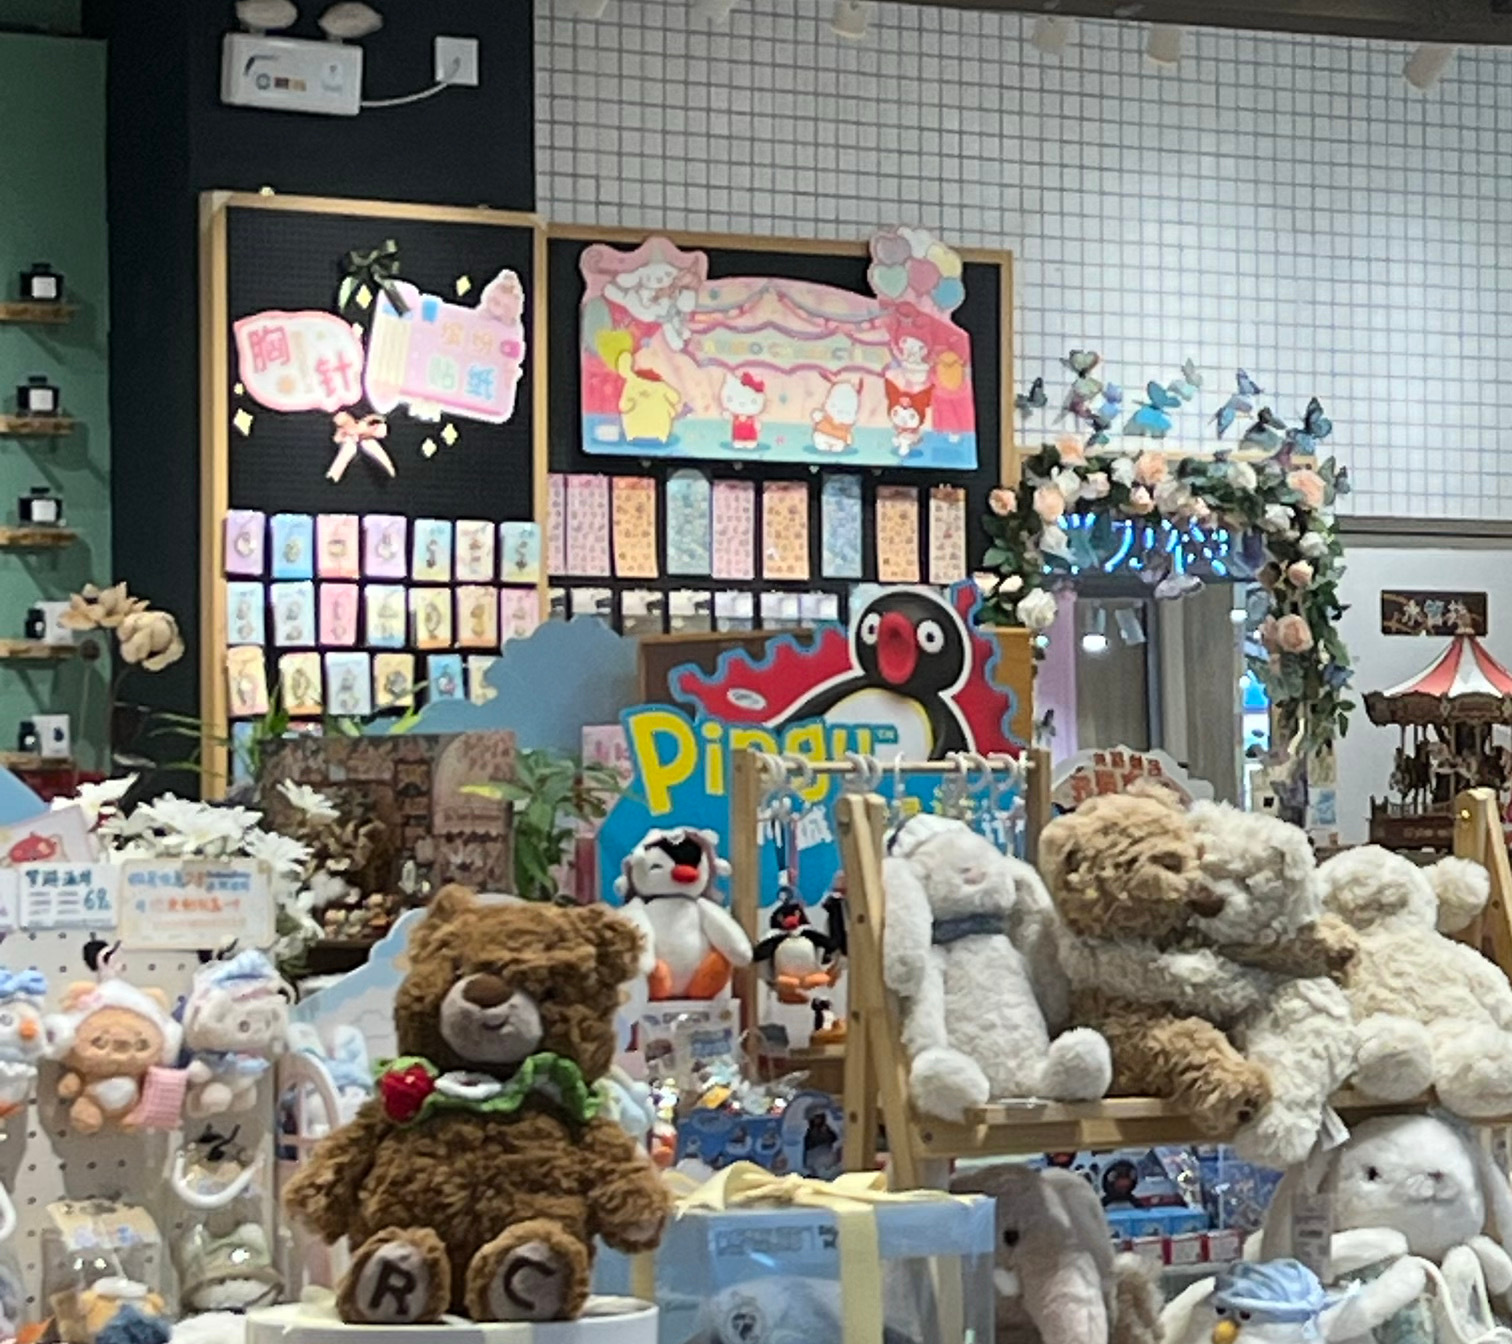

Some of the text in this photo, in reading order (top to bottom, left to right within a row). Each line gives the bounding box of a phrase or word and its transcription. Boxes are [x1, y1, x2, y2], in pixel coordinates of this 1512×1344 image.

[248, 324, 353, 398] 胸针
[368, 1256, 557, 1315] R C
